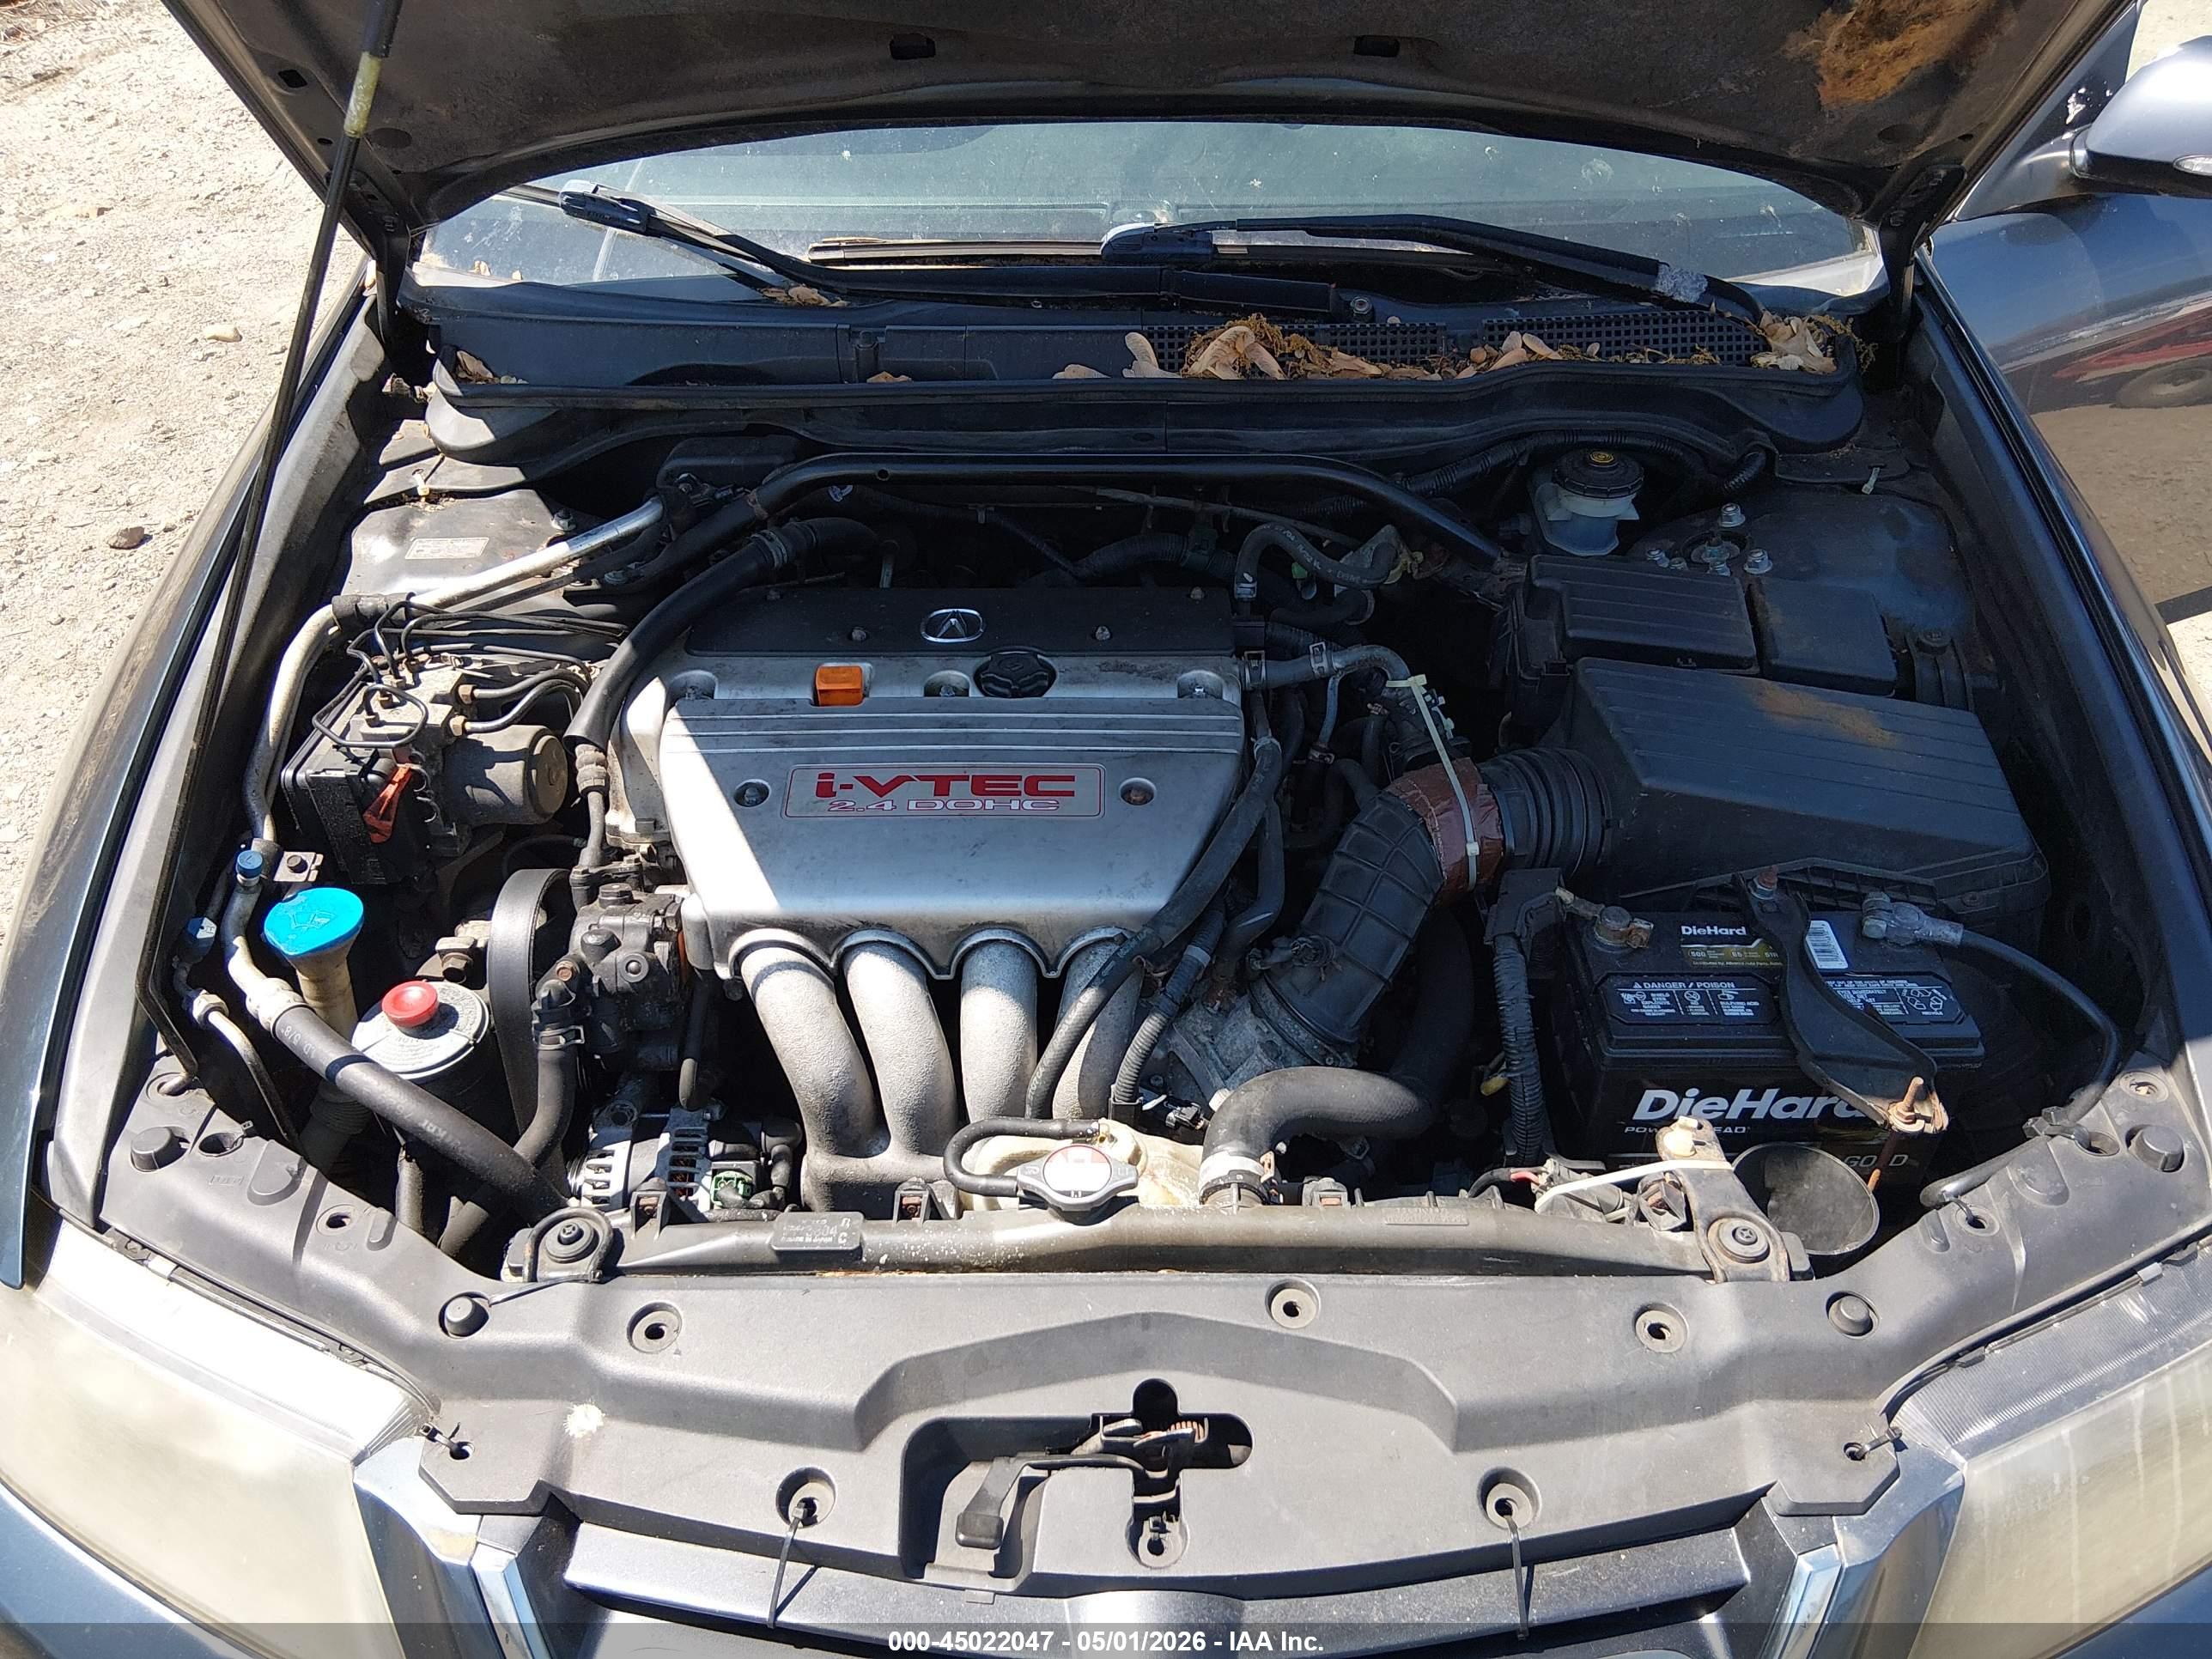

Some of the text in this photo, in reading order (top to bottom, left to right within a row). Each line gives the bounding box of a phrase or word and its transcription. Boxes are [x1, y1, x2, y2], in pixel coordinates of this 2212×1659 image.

[816, 773, 1075, 798] i-VTEC
[828, 799, 1060, 811] 2.4 DOHC
[1680, 925, 1747, 935] DieHard
[1845, 1155, 1908, 1167] GOD
